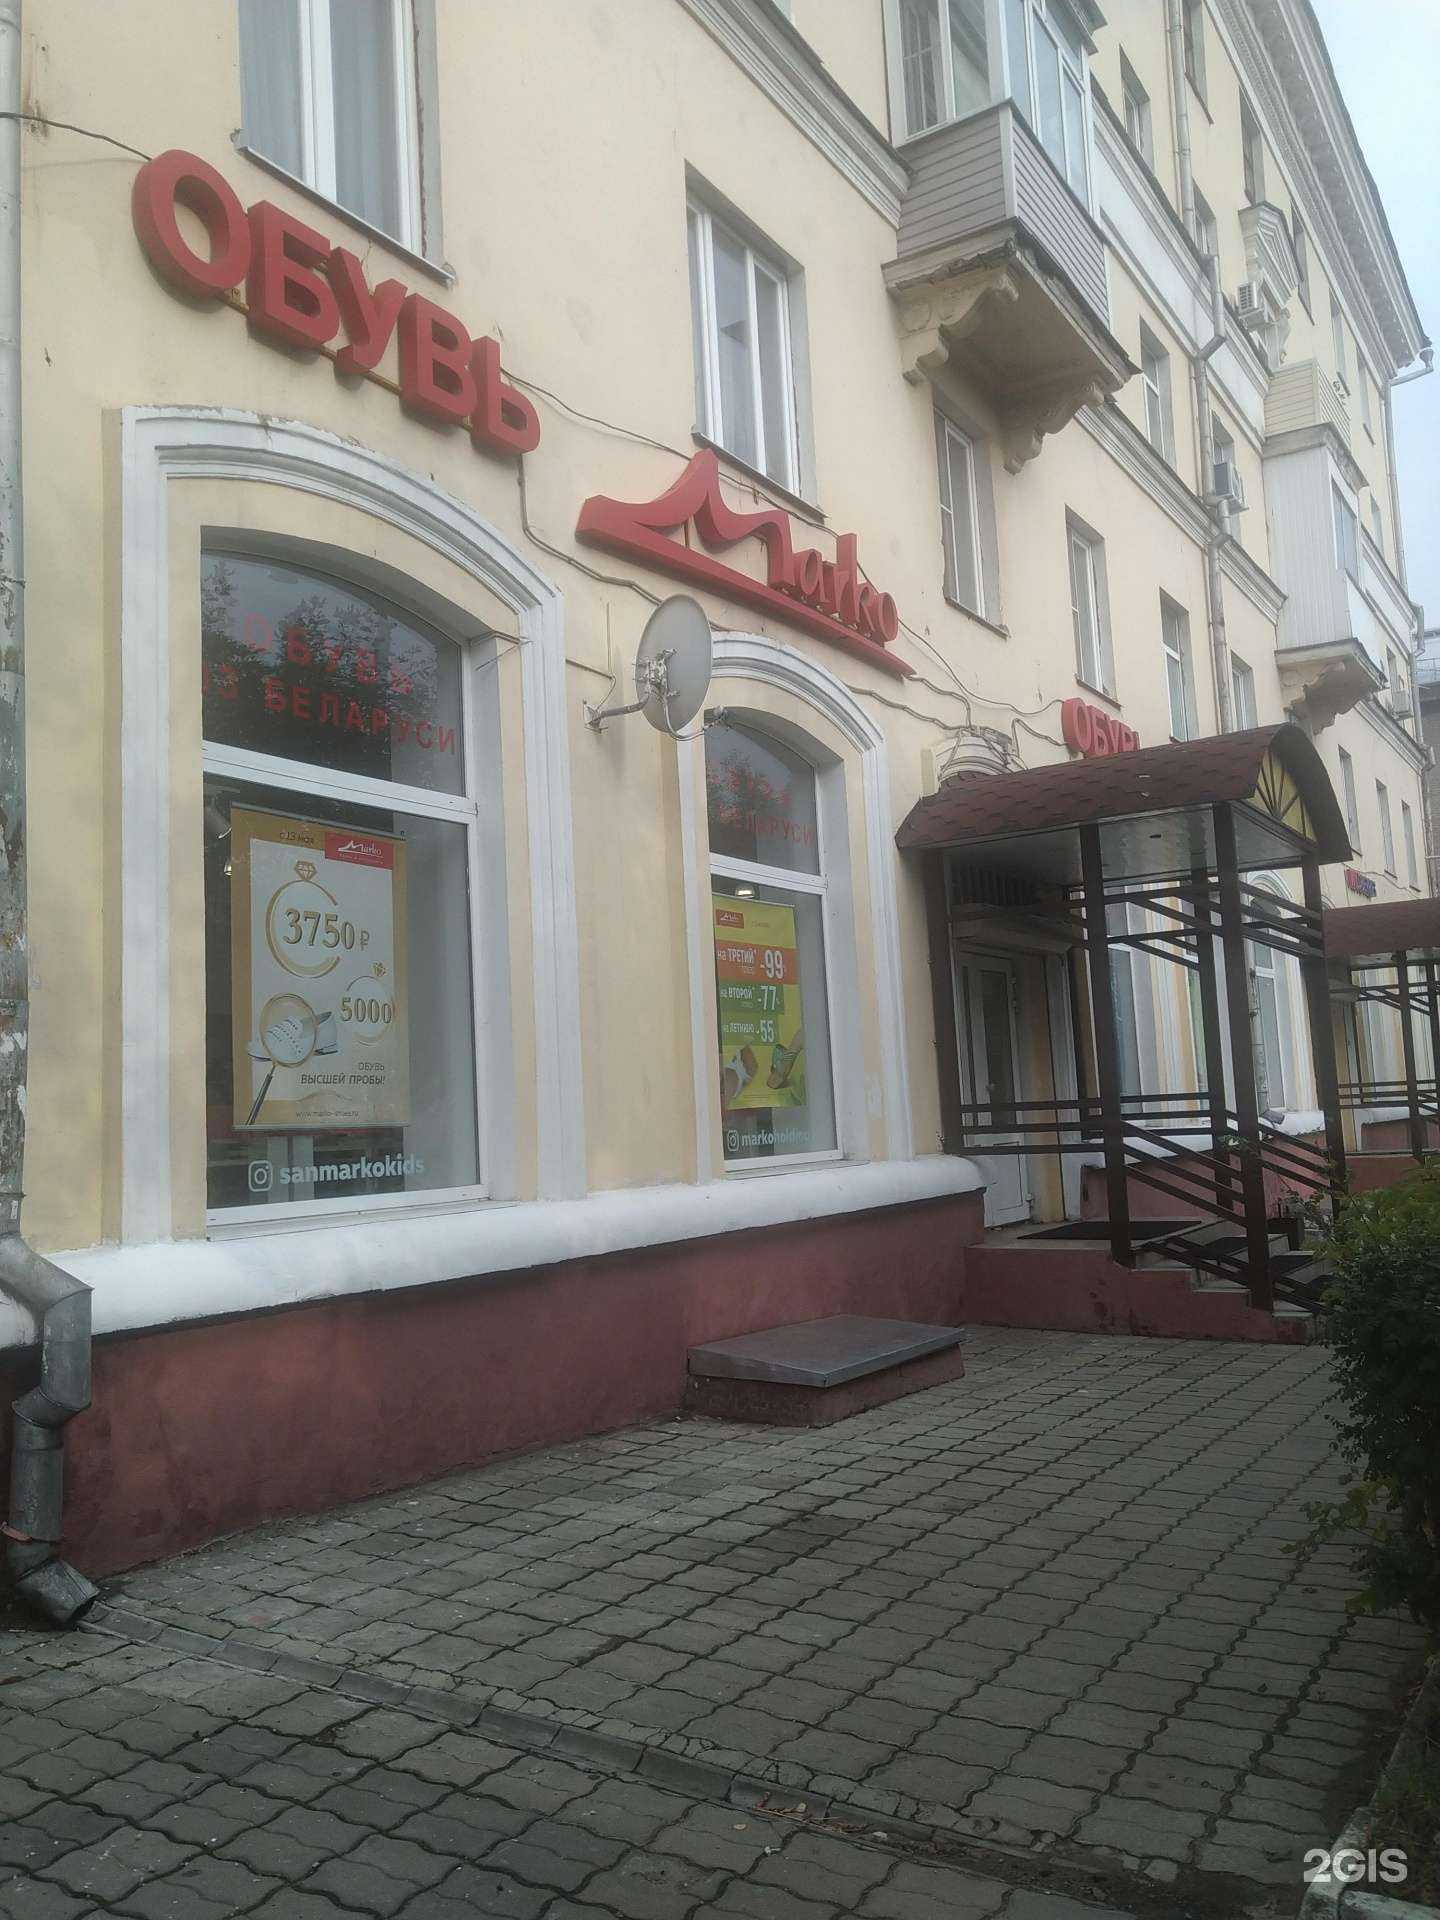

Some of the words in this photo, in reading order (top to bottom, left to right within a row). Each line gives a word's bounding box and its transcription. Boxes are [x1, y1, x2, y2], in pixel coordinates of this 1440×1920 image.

[131, 149, 540, 455] ОБУВЬ
[575, 448, 916, 682] Marko
[244, 611, 415, 696] ОБУВЬ
[262, 677, 457, 755] БЕЛАРУСИ
[337, 839, 384, 858] Marko
[282, 907, 355, 951] 3750
[340, 997, 392, 1025] 5000
[300, 1072, 346, 1085] ВЫСШЕЙ
[349, 1074, 386, 1085] ПРОБЫ!
[358, 1062, 385, 1071] ОБУВЬ
[279, 1152, 425, 1185] sanmarkokids
